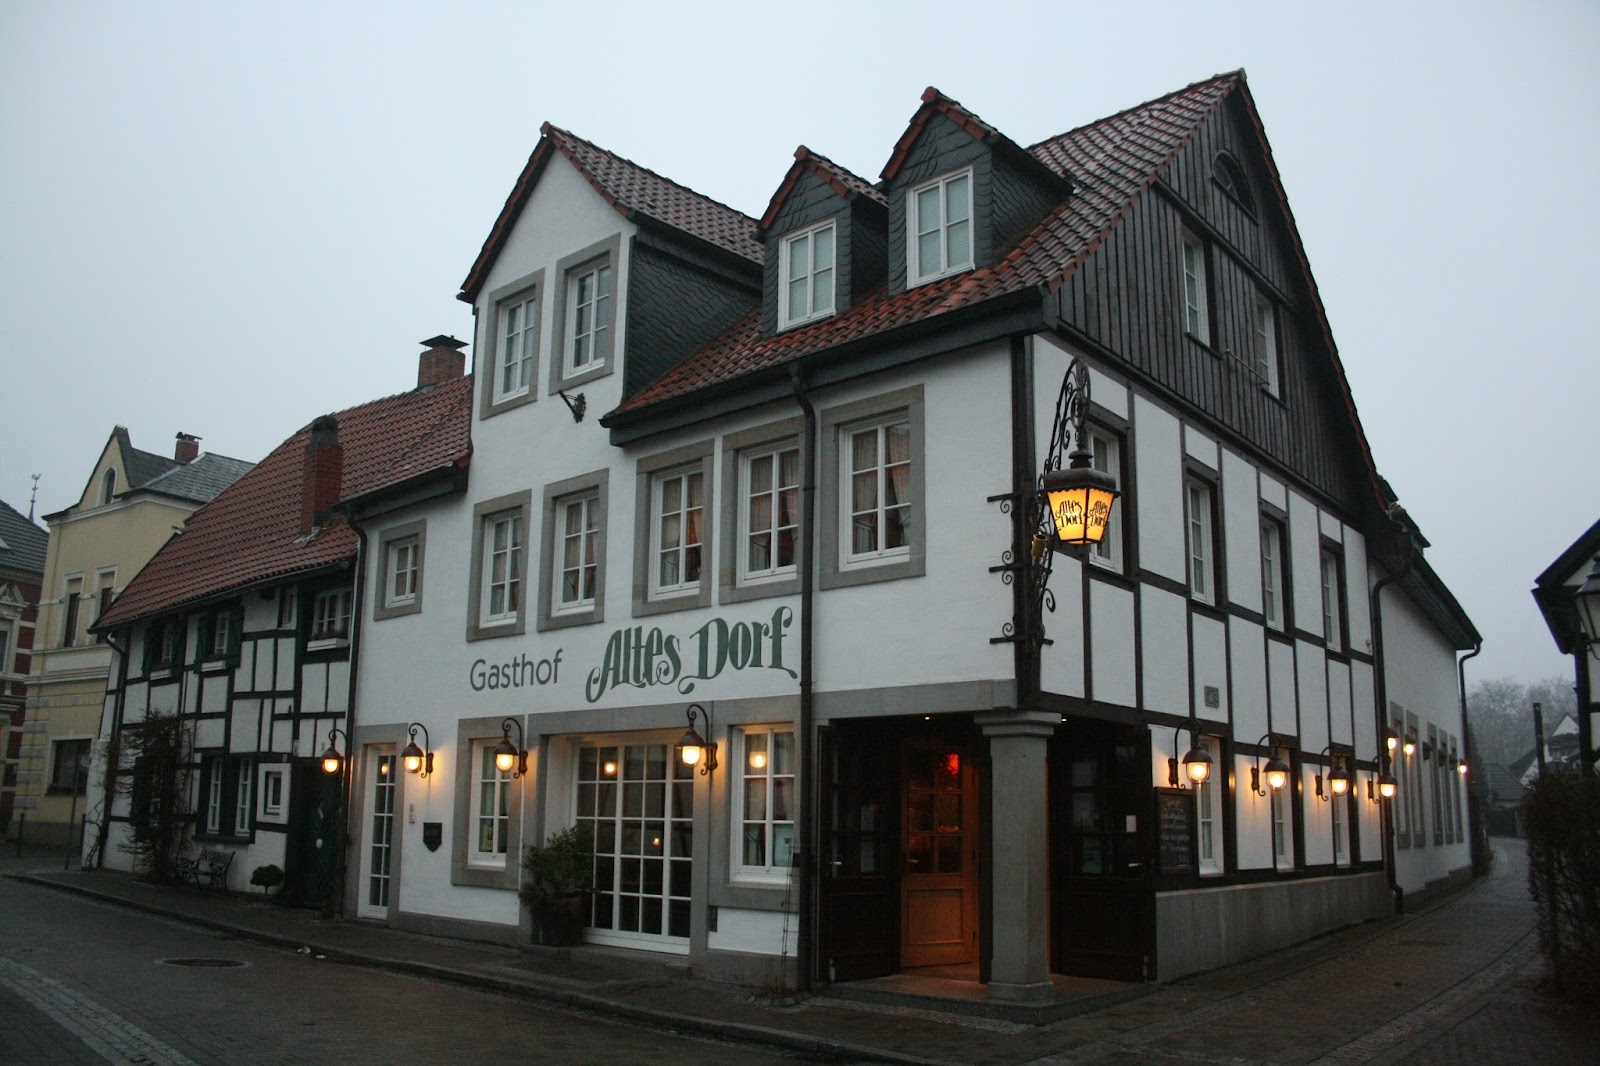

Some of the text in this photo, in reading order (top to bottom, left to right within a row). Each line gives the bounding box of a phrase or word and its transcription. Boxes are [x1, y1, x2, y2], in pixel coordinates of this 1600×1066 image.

[1055, 500, 1083, 519] Altes
[469, 605, 798, 703] Gasthof Altes Dorf
